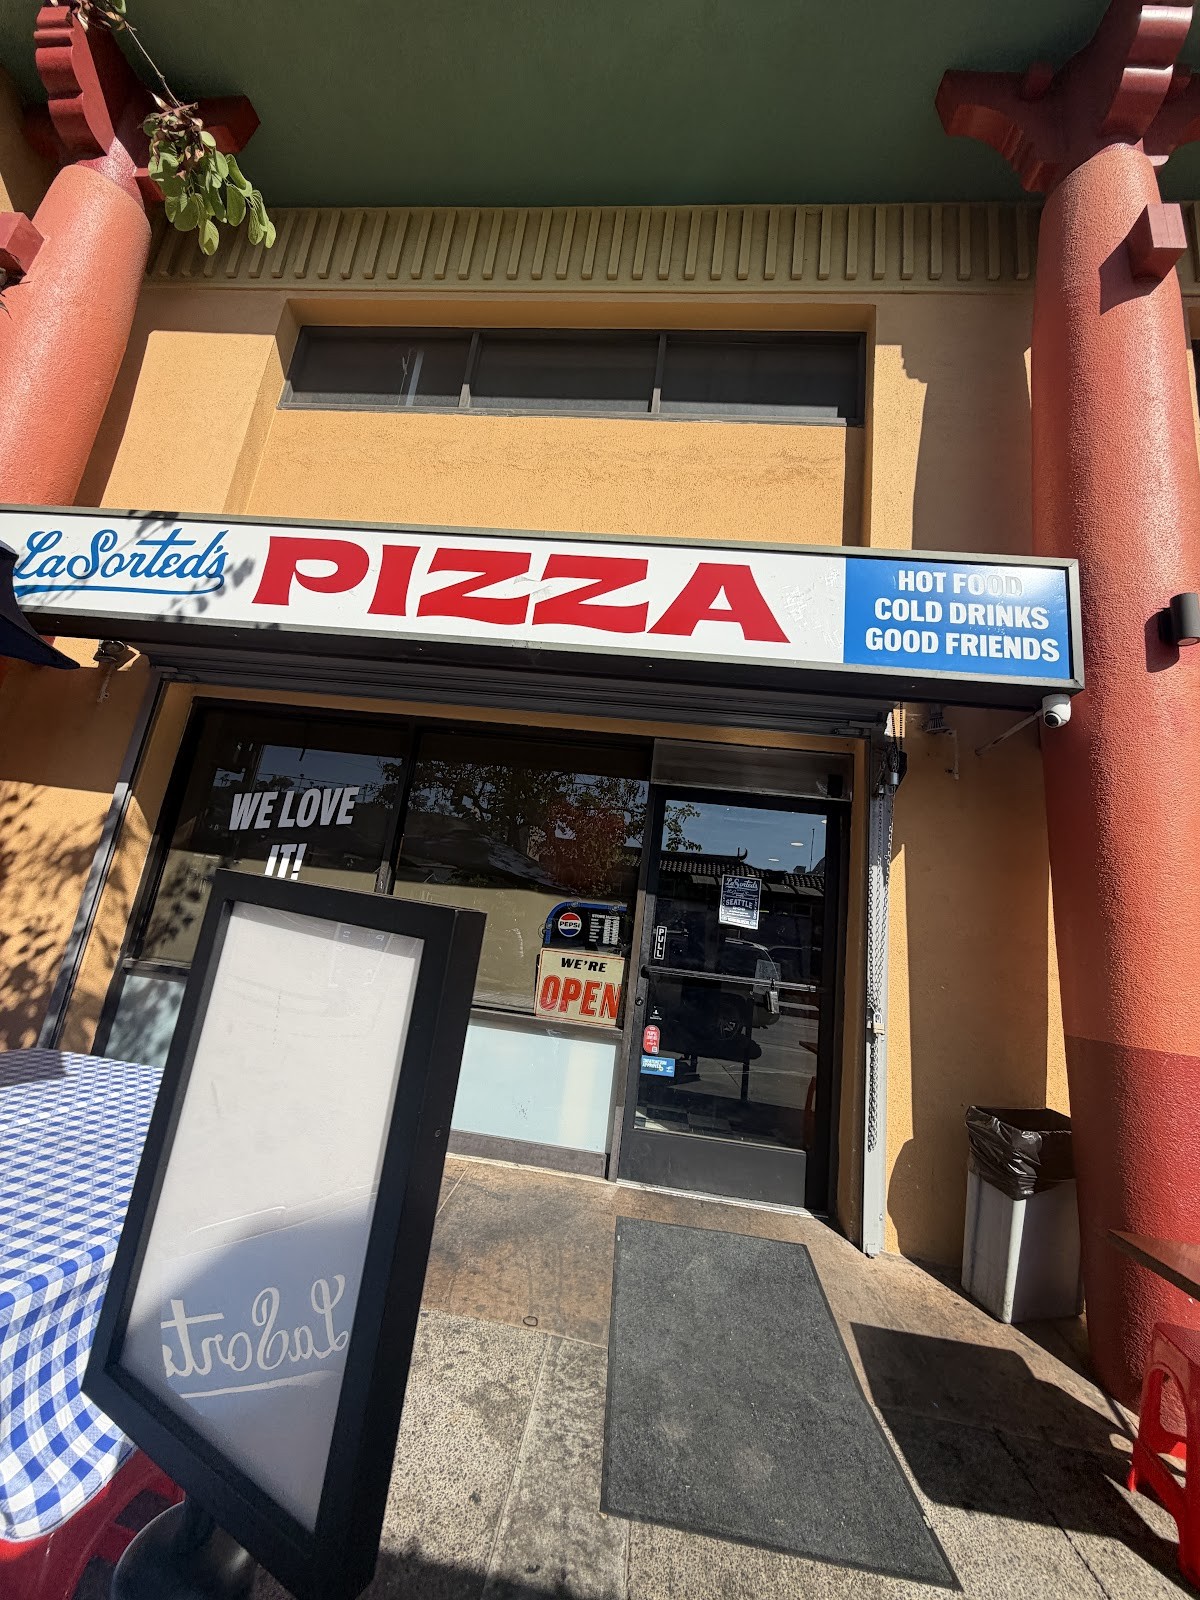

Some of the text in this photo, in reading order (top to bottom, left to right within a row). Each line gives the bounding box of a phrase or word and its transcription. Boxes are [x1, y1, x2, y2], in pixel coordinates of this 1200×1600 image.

[13, 528, 229, 588] LaSorted's
[252, 535, 791, 644] PIZZA
[898, 569, 1023, 598] HOT FOOD
[874, 597, 1050, 630] COLD DRINKS
[865, 627, 1060, 662] GOOD FRIENDS
[228, 786, 361, 831] WE LOVE
[264, 842, 308, 881] IT!
[725, 898, 752, 909] SEATTLE
[559, 920, 581, 928] PEPSI
[656, 928, 665, 957] PULL
[561, 957, 607, 973] WE'RE
[540, 974, 621, 1020] OPEN
